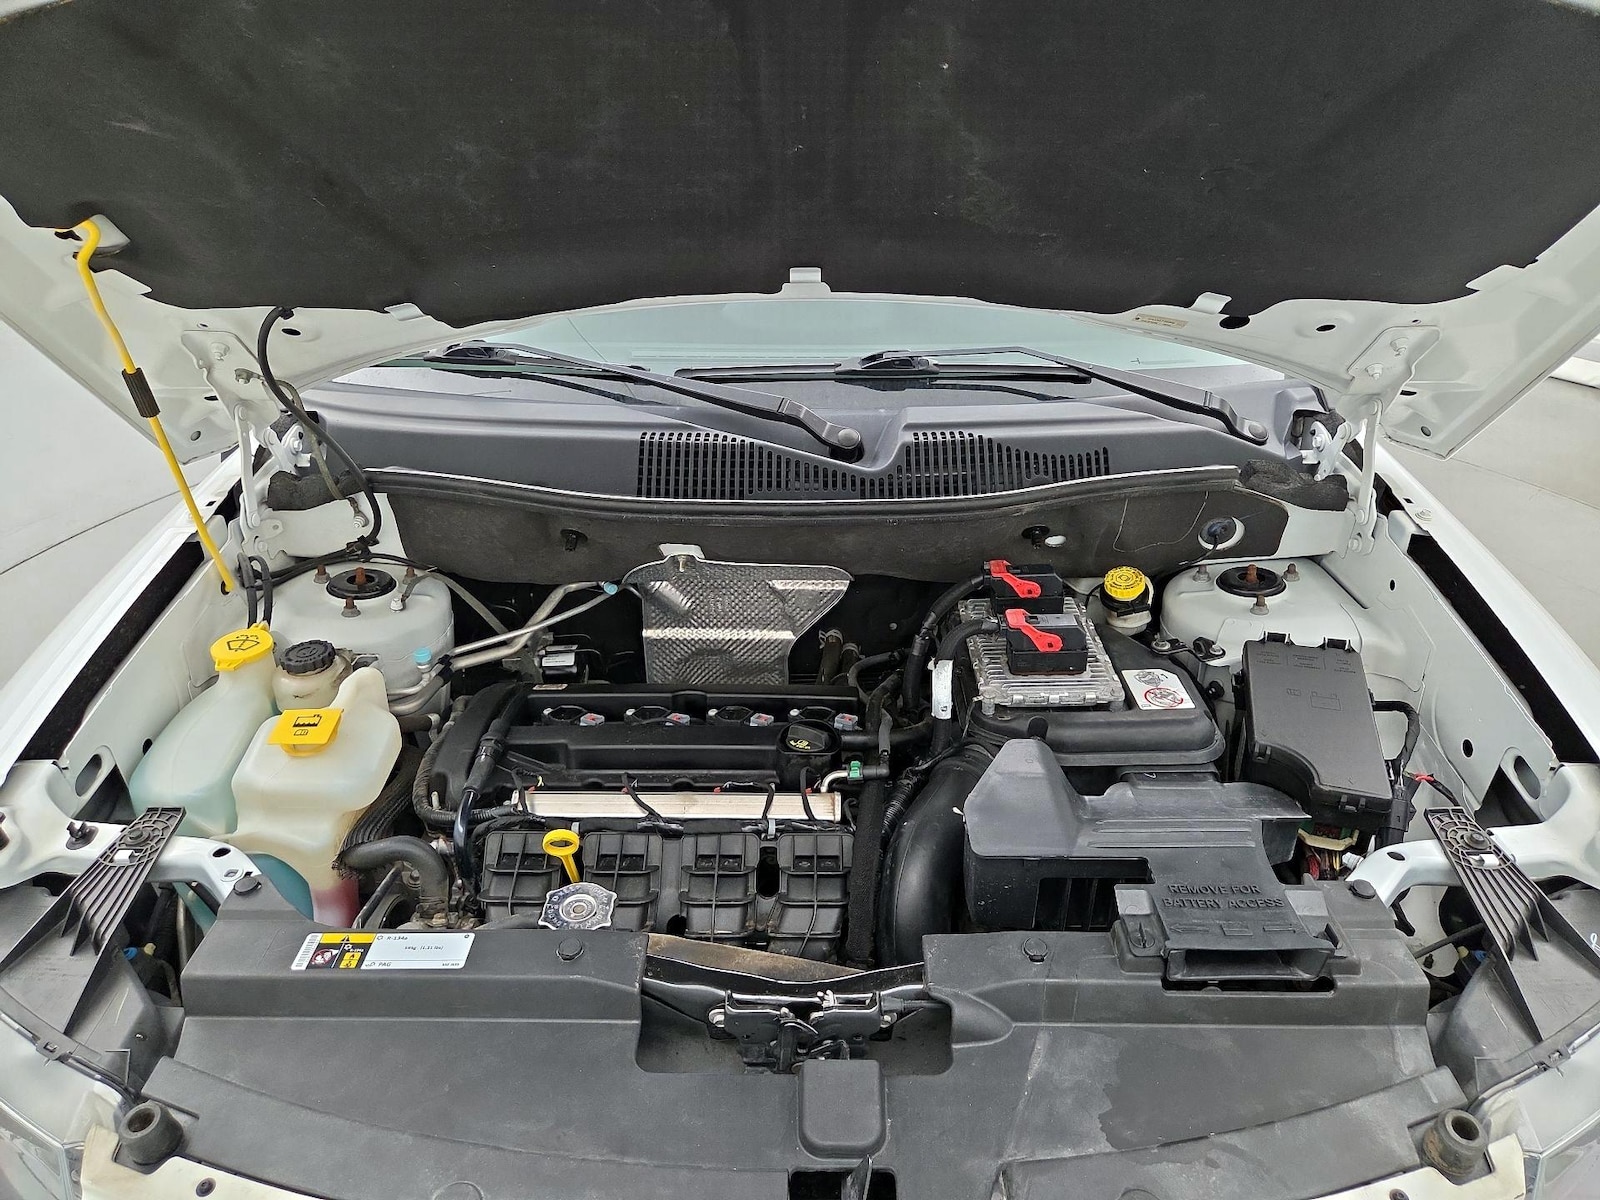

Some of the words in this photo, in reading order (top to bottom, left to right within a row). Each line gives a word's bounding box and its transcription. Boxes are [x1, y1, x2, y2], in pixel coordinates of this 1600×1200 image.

[1168, 884, 1228, 895] REMOVE
[1231, 884, 1261, 894] FOR
[1162, 897, 1222, 909] BATTERY
[1227, 897, 1285, 909] ACCESS
